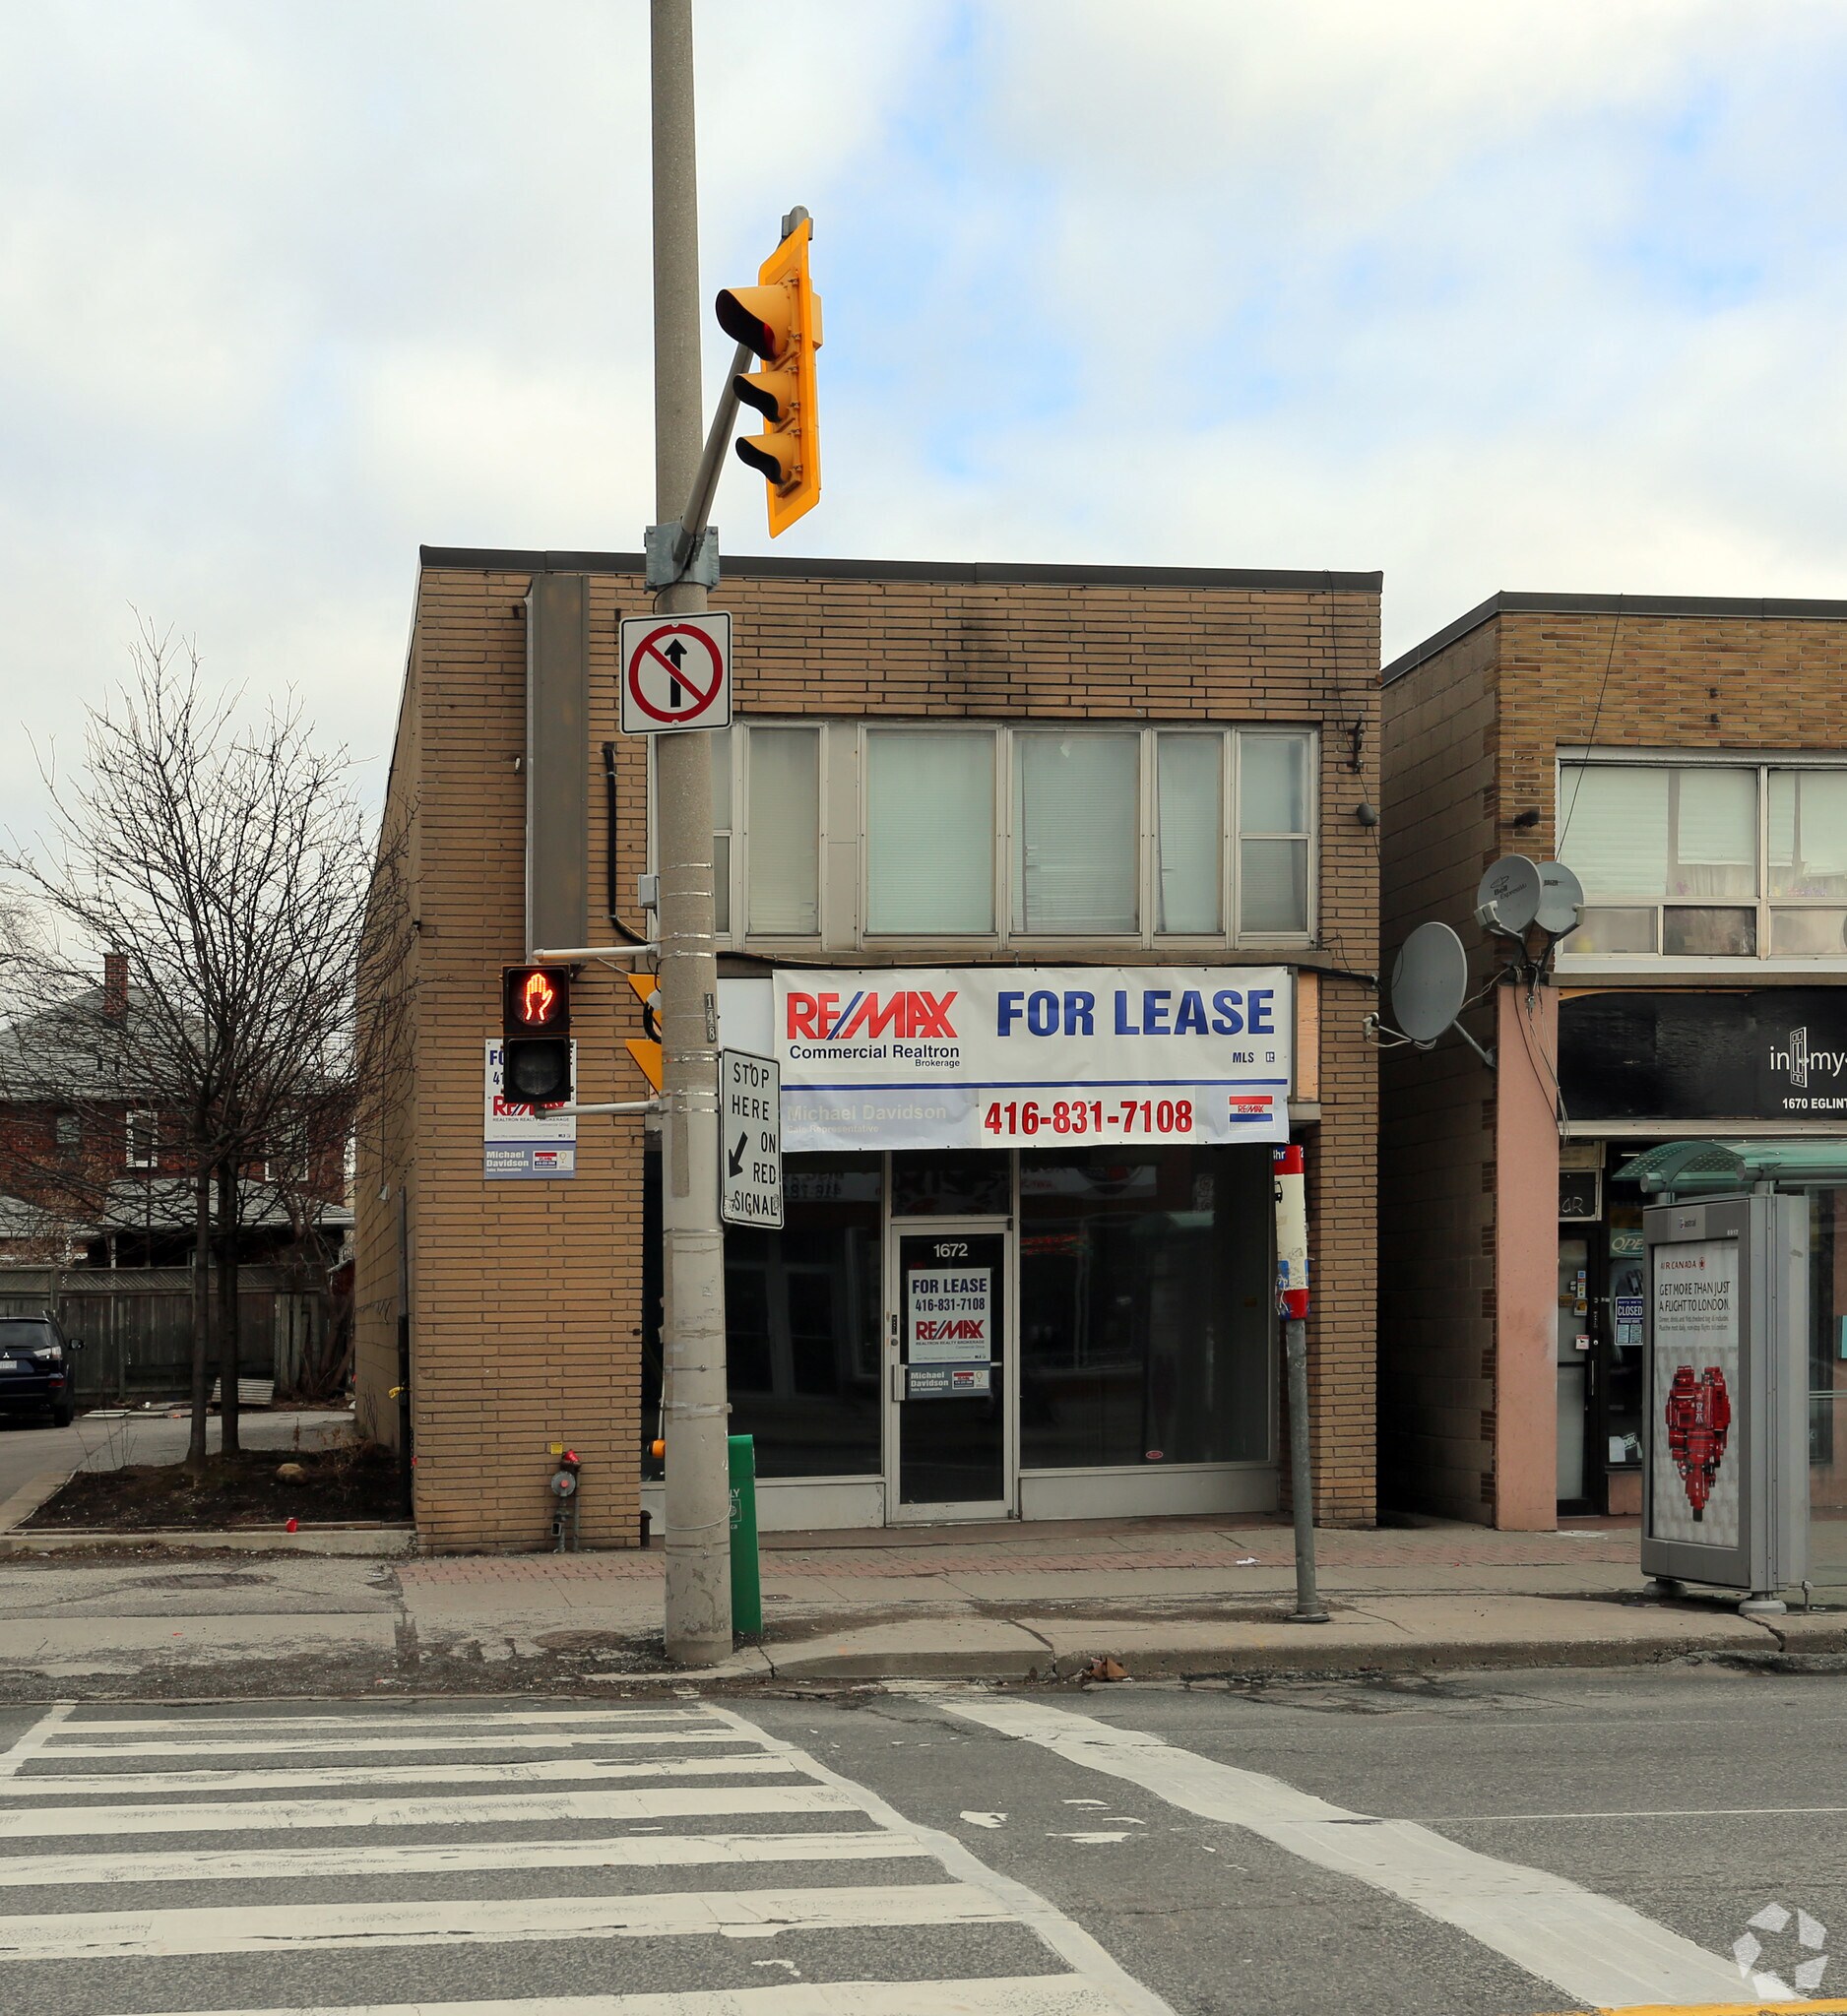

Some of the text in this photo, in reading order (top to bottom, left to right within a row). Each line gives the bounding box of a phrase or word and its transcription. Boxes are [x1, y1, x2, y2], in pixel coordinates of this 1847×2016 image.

[707, 994, 715, 1040] 148
[788, 991, 958, 1040] RE/MAX
[997, 990, 1274, 1037] FOR LEASE
[789, 1044, 960, 1059] Commercial Realtron
[1232, 1051, 1254, 1063] MLS
[915, 1059, 960, 1069] Brokerage
[733, 1062, 769, 1089] STOP
[732, 1095, 769, 1121] HERE
[1783, 1098, 1808, 1109] 1670
[788, 1104, 947, 1121] Michael Davidson
[985, 1100, 1193, 1134] 416-831-7108
[761, 1132, 776, 1153] ON
[753, 1162, 776, 1185] RED
[734, 1190, 777, 1216] SIGNAL
[933, 1243, 968, 1258] 1672
[1611, 1236, 1643, 1251] OPE
[1660, 1260, 1697, 1270] AIR CANADA
[912, 1278, 987, 1294] FOR LEASE
[1659, 1281, 1731, 1296] GET MORE THAN JUST
[915, 1298, 985, 1312] 416-831-7108
[1618, 1305, 1643, 1316] CLOSED
[1659, 1300, 1664, 1312] A
[1665, 1300, 1687, 1312] FLIGHT
[1688, 1299, 1697, 1311] TO
[916, 1320, 985, 1340] RE/MAX
